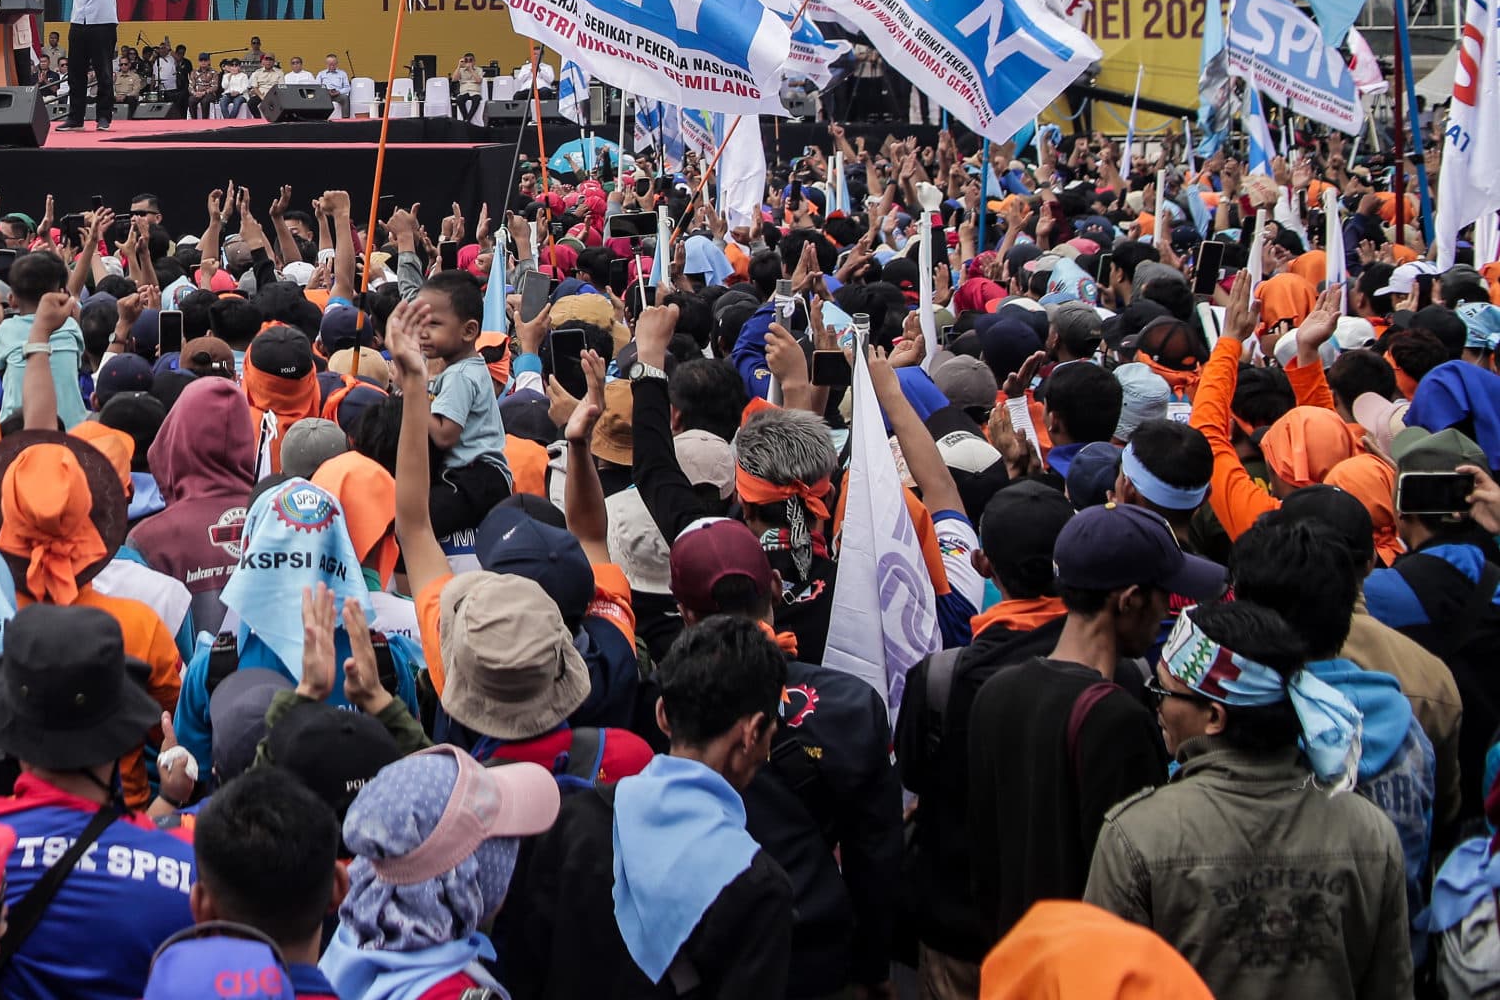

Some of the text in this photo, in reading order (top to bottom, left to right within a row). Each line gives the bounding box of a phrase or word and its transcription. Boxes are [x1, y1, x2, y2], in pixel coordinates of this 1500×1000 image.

[577, 31, 659, 71] NIKOMAS
[664, 66, 761, 99] GEMILANG
[585, 13, 632, 45] SERIKAT
[636, 37, 688, 70] PEKERJA
[693, 59, 757, 86] NASIONAL
[903, 39, 947, 78] NIKOMAS
[915, 28, 946, 55] SERIKAT
[942, 50, 974, 82] PEKERJA
[296, 493, 318, 505] SPSI
[241, 551, 347, 582] KSPSI AGN
[107, 845, 191, 895] SPSI
